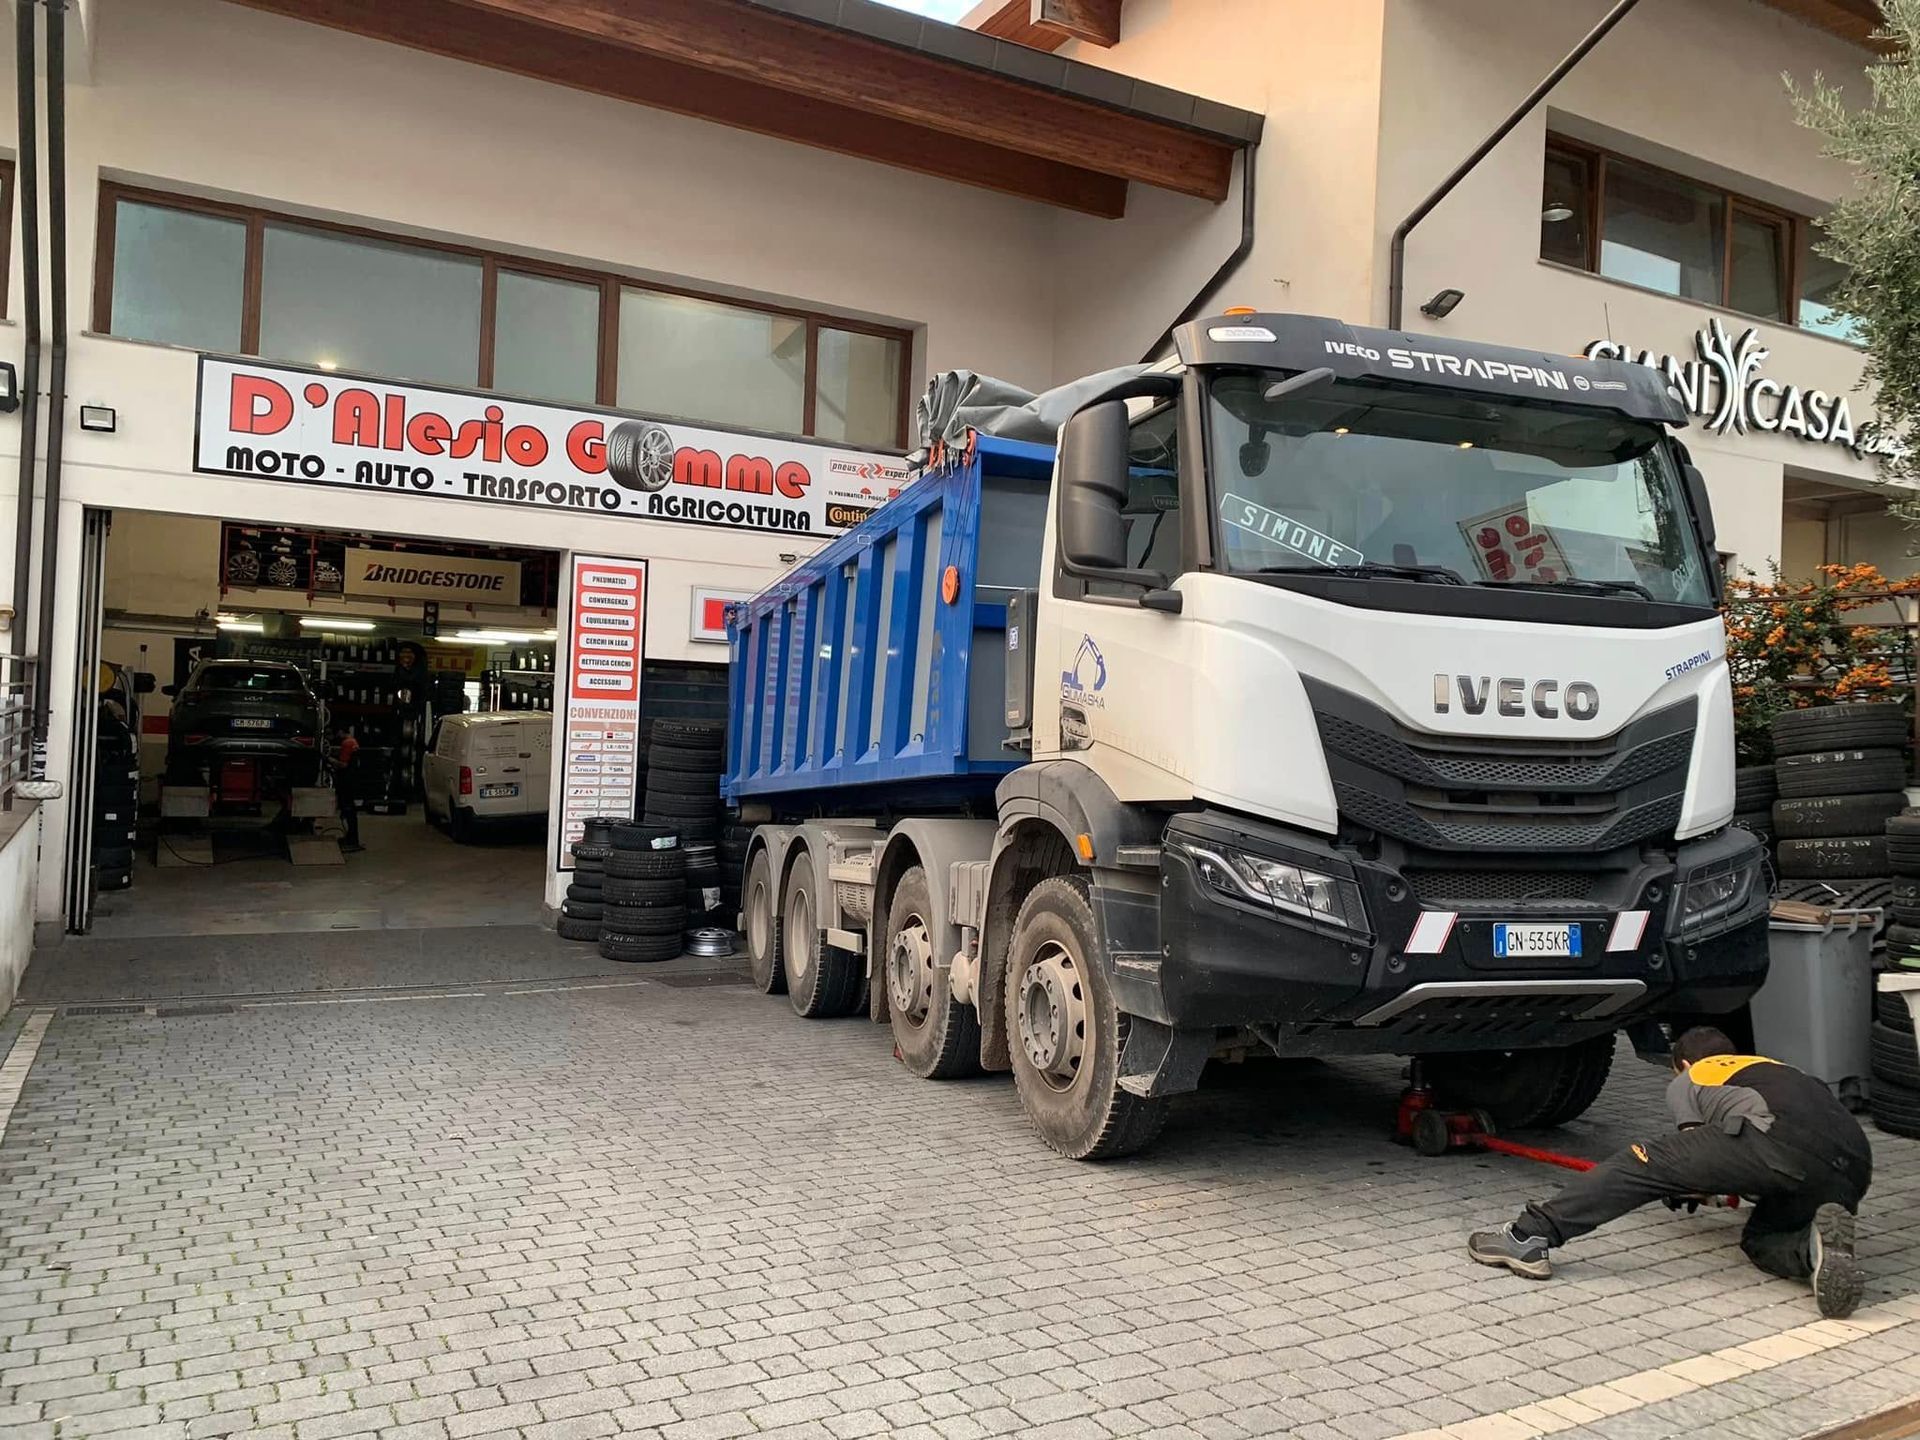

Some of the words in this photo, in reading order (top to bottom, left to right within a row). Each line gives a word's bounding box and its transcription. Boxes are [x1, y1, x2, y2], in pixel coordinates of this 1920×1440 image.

[1324, 341, 1380, 361] IVECO
[1387, 348, 1569, 391] STRAPPINI
[1751, 378, 1855, 446] CASA
[832, 462, 857, 473] pneus
[885, 470, 909, 480] expert
[226, 445, 325, 479] MOTO
[355, 460, 434, 490] AUTO
[463, 473, 622, 510] TRASPORTO
[648, 493, 811, 530] AGRICOLTURA
[829, 506, 868, 524] Contin
[1240, 505, 1343, 567] SIMONE
[363, 563, 505, 591] BRIDGESTONE
[592, 576, 627, 585] PNEUMATICI
[588, 596, 628, 606] CONVERGENZA
[586, 616, 630, 626] EQUILIBRATURA
[585, 637, 607, 646] CERCHI
[615, 639, 628, 647] LEGA
[581, 658, 610, 667] RETTIFICA
[610, 659, 631, 668] CERCHI
[1664, 650, 1712, 681] STRAPPINI
[589, 678, 621, 686] ACCESSORI
[1433, 673, 1600, 721] IVECO
[570, 706, 637, 720] CONVENZIONI
